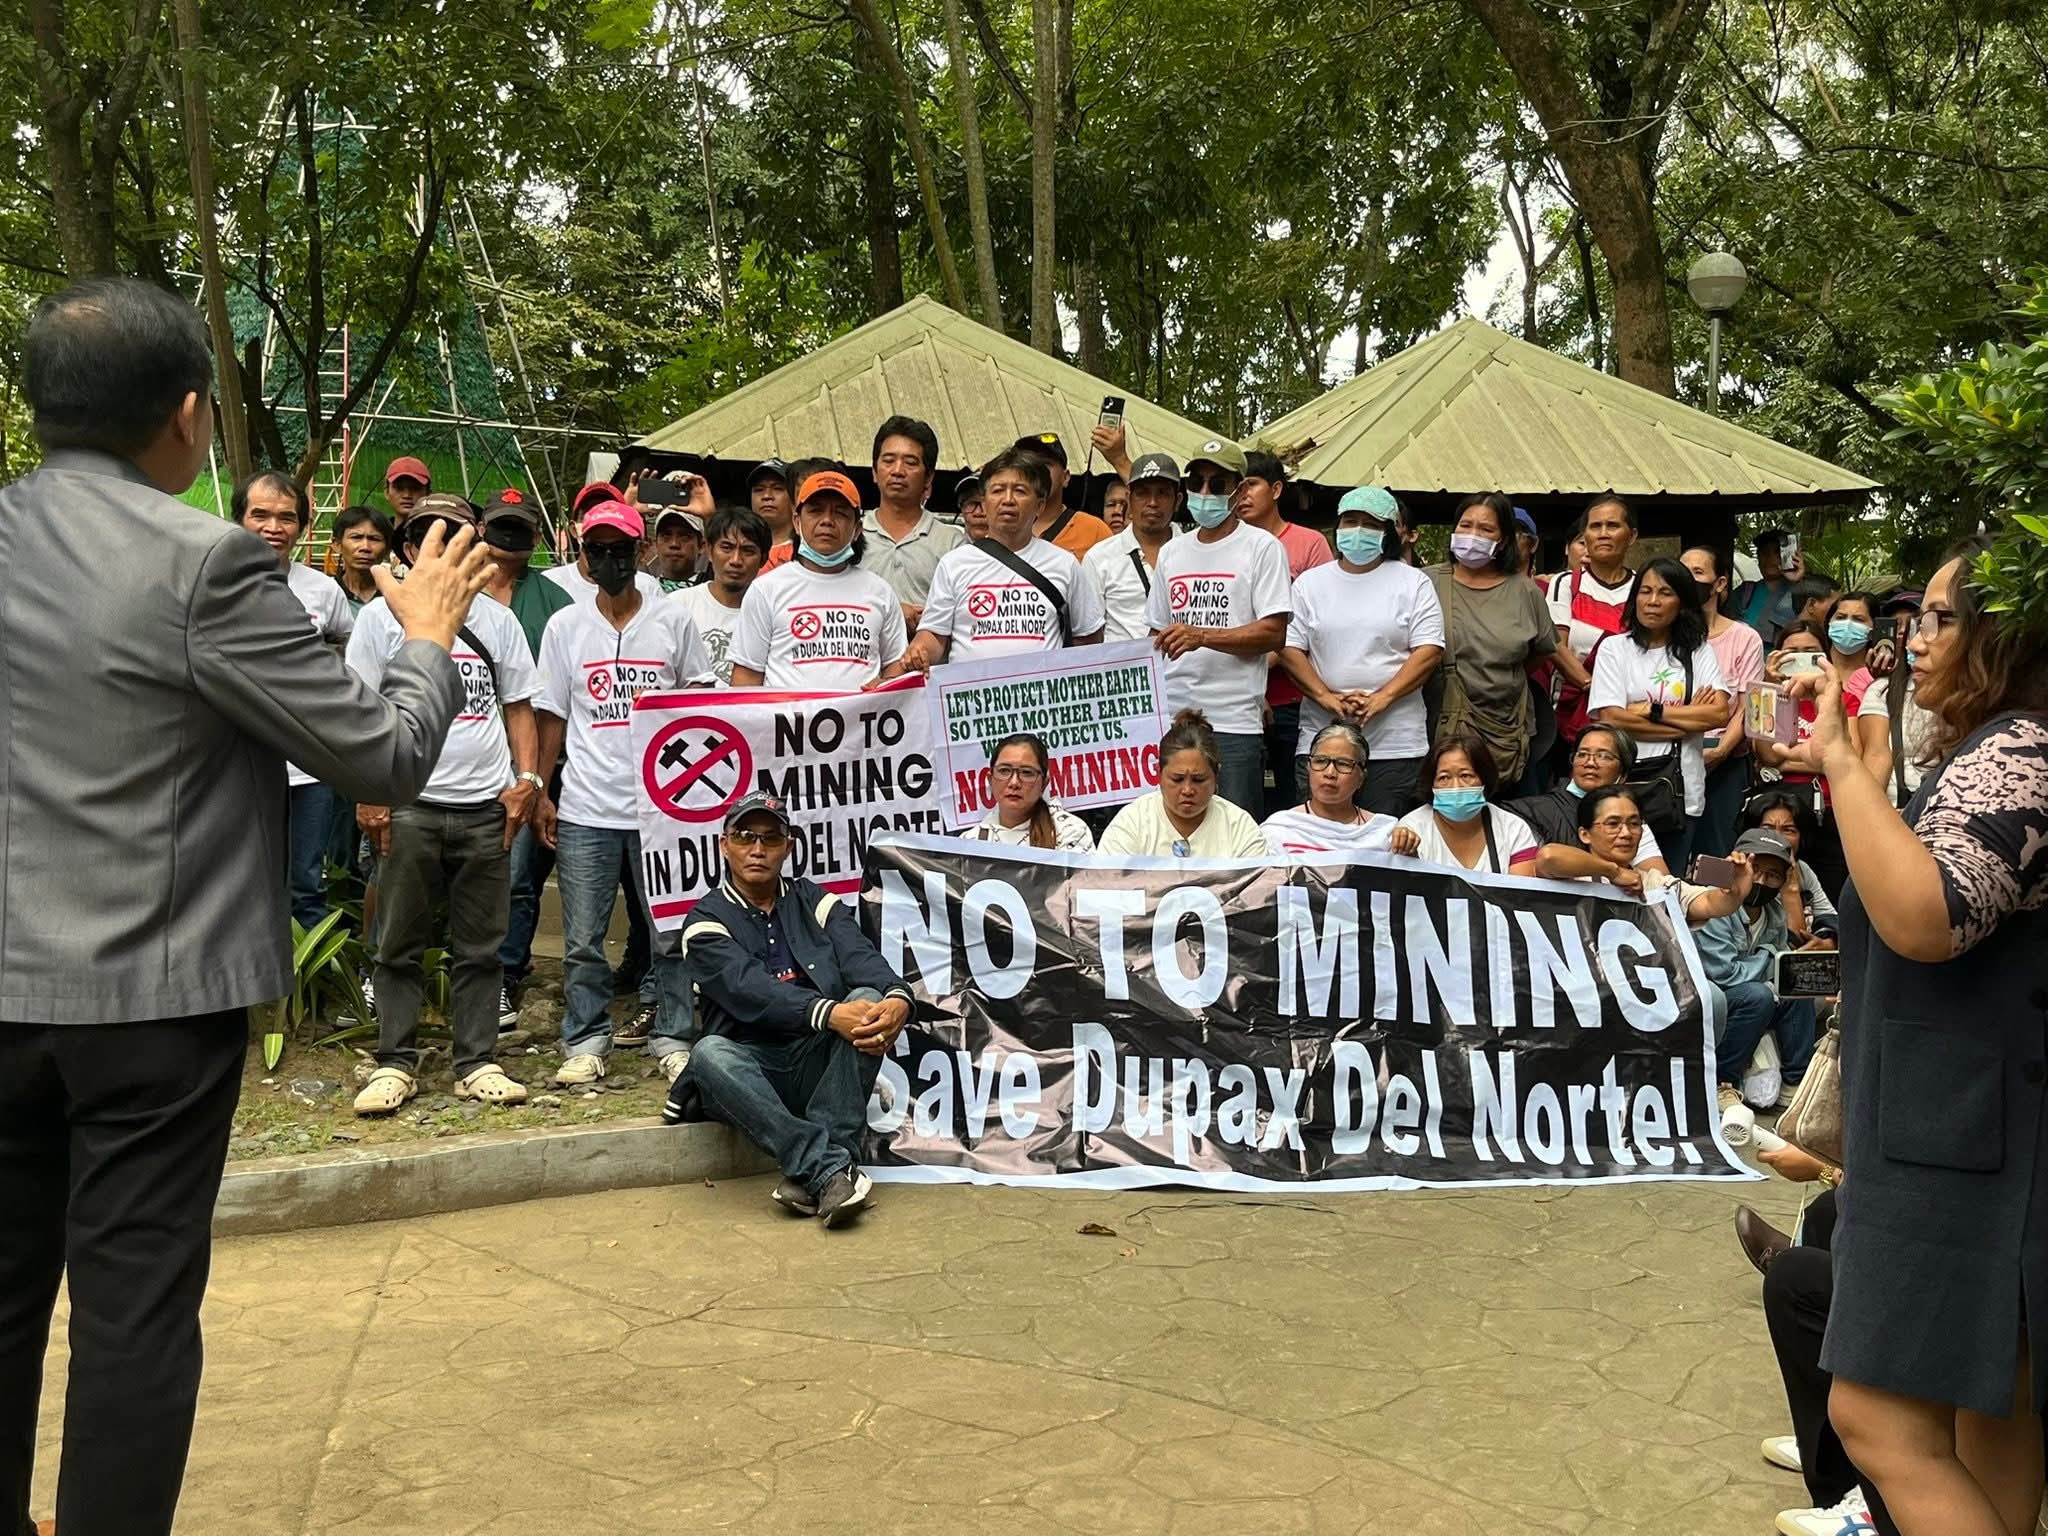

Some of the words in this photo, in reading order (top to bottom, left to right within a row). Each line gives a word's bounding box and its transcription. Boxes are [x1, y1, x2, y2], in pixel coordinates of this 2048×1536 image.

[1193, 580, 1210, 593] NO
[1213, 582, 1224, 592] TO
[1002, 589, 1021, 602] NO
[1025, 591, 1039, 601] TO
[826, 611, 847, 623] NO
[851, 613, 864, 624] TO
[997, 604, 1046, 617] MINING
[1205, 611, 1229, 627] NORTE
[822, 625, 870, 640] MINING
[1005, 619, 1019, 633] DEL
[800, 642, 828, 658] DUPAX
[831, 641, 845, 656] DEL
[456, 661, 472, 676] O
[477, 665, 488, 678] TO
[617, 667, 637, 682] NO
[641, 671, 657, 683] TO
[465, 680, 491, 695] NING
[946, 687, 982, 719] LET'S
[984, 680, 1045, 714] PROTECT
[1048, 673, 1105, 704] MOTHER
[1105, 666, 1150, 696] EARTH
[599, 702, 621, 720] DPAX
[950, 720, 970, 742] SO
[973, 715, 1019, 738] THAT
[1022, 704, 1094, 731] MOTHER
[1097, 695, 1153, 720] EARTH
[774, 708, 845, 757] NO
[859, 708, 904, 748] TO
[1037, 725, 1099, 749] ROTECT
[1103, 721, 1128, 741] US.
[1048, 744, 1161, 798] MINING
[757, 753, 933, 812] MINING
[646, 849, 671, 896] IN
[790, 821, 840, 879] DEL
[879, 869, 1037, 1000] NO
[1076, 886, 1230, 1009] TO
[1276, 885, 1681, 1033] MINING
[866, 1027, 1042, 1140] Save
[1071, 1022, 1306, 1167] Dupax
[1331, 1041, 1446, 1158] Del
[1469, 1049, 1704, 1166] Norte!
